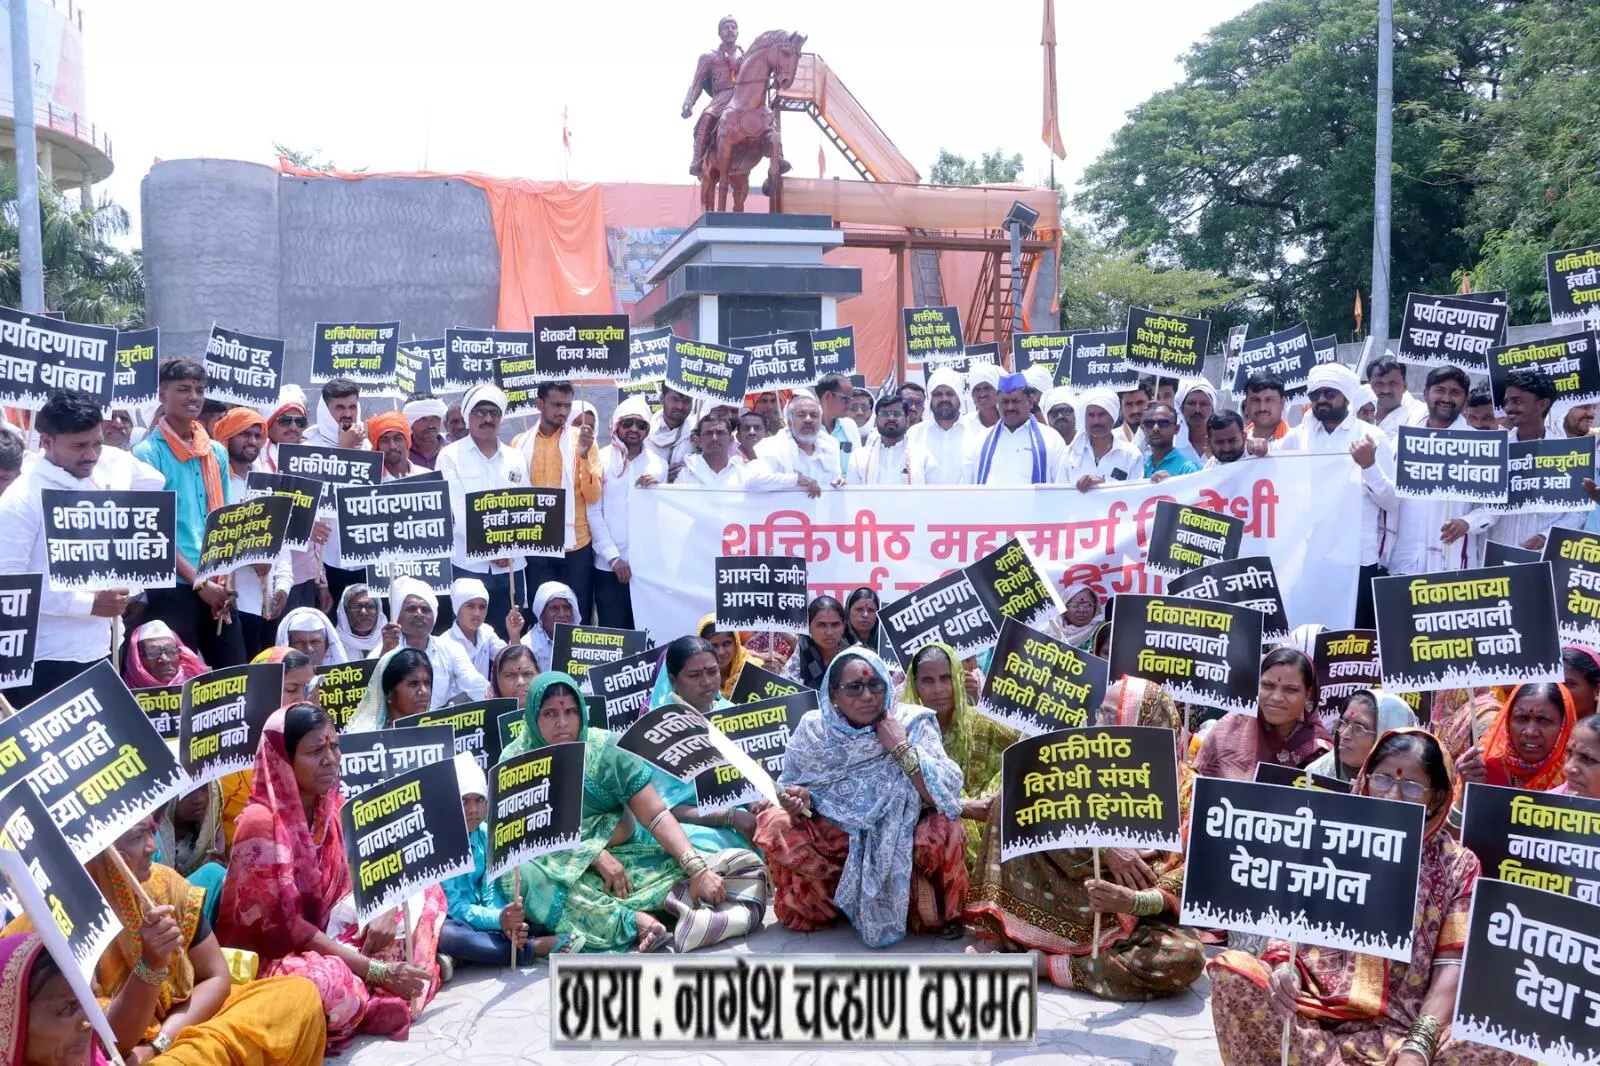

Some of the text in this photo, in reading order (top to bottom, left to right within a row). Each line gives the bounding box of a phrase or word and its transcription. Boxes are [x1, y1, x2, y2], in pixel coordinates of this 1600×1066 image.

[1144, 317, 1187, 334] शक्तीपीठ
[1414, 301, 1499, 331] पर्यावरणाचा
[324, 326, 394, 341] शक्तिपीठाला एक
[452, 336, 528, 355] शेतकरी जगवा
[540, 326, 625, 344] शेतकरी एकजुटीचा
[1136, 329, 1195, 349] विरोधी संघर्ष
[1276, 333, 1307, 354] जगवा
[115, 344, 154, 368] जुटीचा
[250, 347, 272, 367] रद्द
[331, 341, 385, 355] इंचही जमीन
[556, 345, 609, 361] विजय असो
[675, 341, 743, 366] शक्तिपीठाला एक
[821, 352, 839, 365] असो
[1077, 344, 1105, 358] शेतकरी
[1132, 343, 1197, 366] समिती हिंगोली
[1497, 339, 1588, 366] शक्तिपीठाला एक
[332, 355, 357, 369] देणार
[359, 355, 381, 369] नाही
[462, 356, 482, 372] देश
[680, 354, 734, 379] इंचही जमीन
[790, 358, 806, 372] रद्द
[1088, 361, 1111, 375] विजय
[1268, 355, 1301, 374] जगेल
[1541, 357, 1581, 375] जमीन
[40, 360, 106, 394] थांबवा
[234, 366, 277, 389] पाहिजे
[681, 370, 729, 392] देणार नाही
[1405, 432, 1501, 457] पर्यावरणाचा
[289, 454, 372, 479] शक्तीपीठ रद्द
[1448, 459, 1501, 483] थांबवा
[1534, 451, 1591, 472] एकजुटीचा
[1510, 473, 1572, 492] विजय असो
[344, 489, 442, 517] पर्यावरणाचा
[474, 492, 557, 512] शक्तिपीठाला एक
[53, 501, 160, 530] शक्तीपीठ रद्द
[393, 515, 445, 540] थांबवा
[482, 510, 546, 529] इंचही जमीन
[1179, 508, 1231, 536] विकासाच्या
[207, 515, 272, 546] विरोधी संघर्ष
[485, 525, 543, 545] देणार नाही
[722, 509, 915, 563] शक्तिपीठ
[1176, 529, 1226, 554] नावाखाली
[48, 532, 169, 564] झालाच पाहिजे
[718, 564, 769, 586] आमची
[994, 565, 1032, 597] विरोधी
[1222, 566, 1276, 592] जमीन
[722, 591, 805, 611] आमचा हक्क
[999, 588, 1037, 617] समिती
[1409, 576, 1511, 606] विकासाच्या
[1147, 600, 1233, 632] विकासाच्या
[1412, 600, 1512, 633] नावाखाली
[571, 628, 625, 647] विकासाच्या
[1145, 630, 1230, 657] नावाखाली
[1327, 634, 1370, 656] जमीन
[1410, 628, 1522, 662] विनाश नको
[1023, 639, 1087, 677] शक्तीपीठ
[1138, 650, 1231, 684] विनाश नको
[191, 675, 248, 707] विकासाच्या
[1004, 652, 1092, 704] विरोधी संघर्ष
[991, 675, 1088, 727] समिती हिंगोली
[19, 687, 105, 752] आमच्या
[191, 696, 247, 733] नावाखाली
[58, 720, 116, 771] नाही
[189, 721, 250, 763] विनाश नको
[1038, 732, 1132, 764] शक्तीपीठ
[75, 744, 148, 806] बापाची
[498, 756, 553, 793] विकासाच्या
[1023, 763, 1151, 797] विरोधी संघर्ष
[351, 780, 422, 830] विकासाच्या
[497, 778, 551, 819] नावाखाली
[1015, 791, 1163, 827] समिती हिंगोली
[356, 806, 426, 858] नावाखाली
[494, 807, 553, 850] विनाश नको
[1205, 797, 1407, 864] शेतकरी जगवा
[359, 831, 435, 891] विनाश नको
[1229, 845, 1371, 905] देश जगेल
[1515, 959, 1580, 1021] देश
